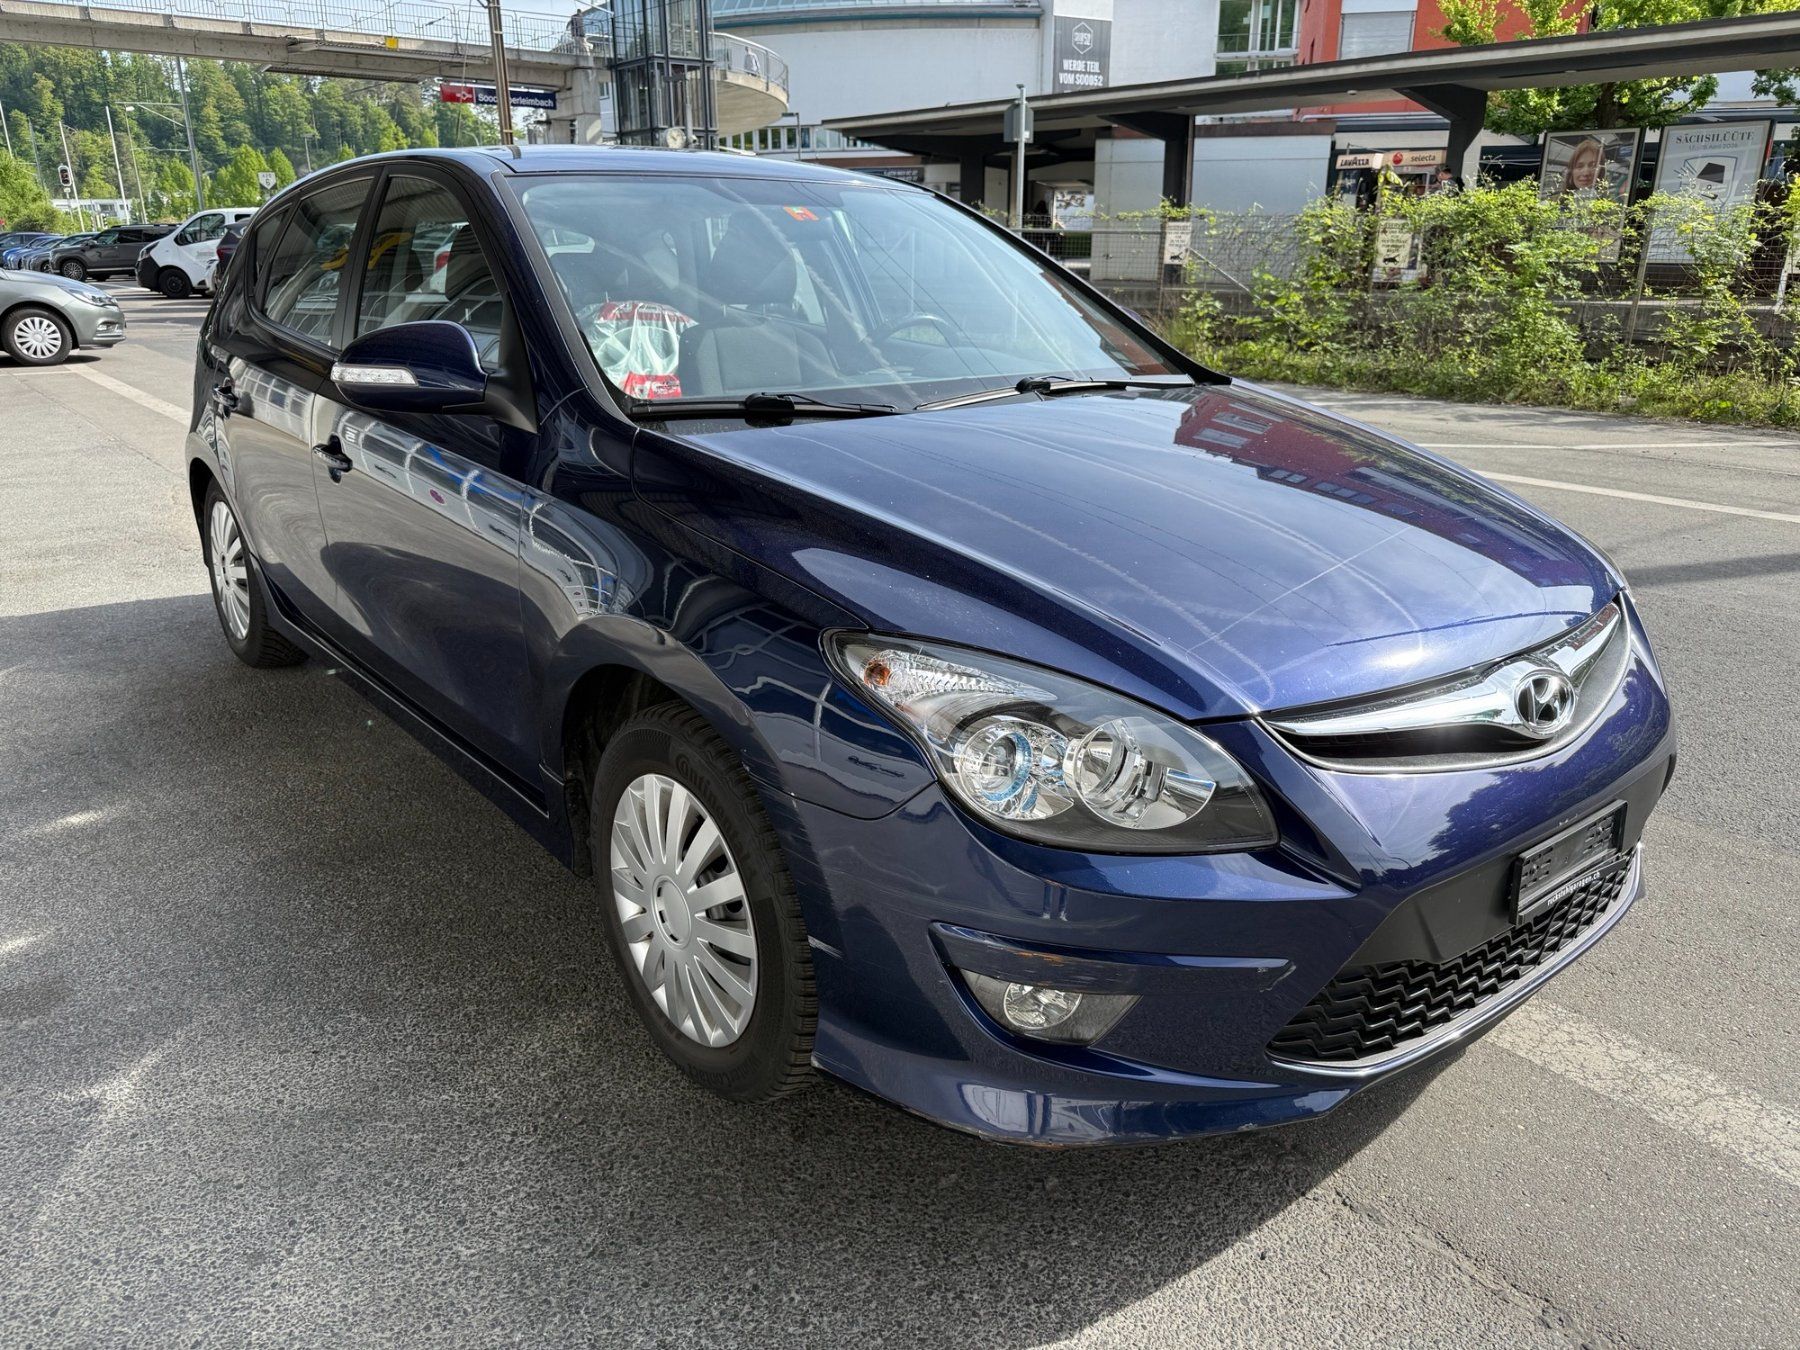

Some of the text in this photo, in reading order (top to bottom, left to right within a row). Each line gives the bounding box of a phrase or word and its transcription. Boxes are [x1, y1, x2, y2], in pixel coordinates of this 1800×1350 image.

[1063, 59, 1100, 73] WERDE TEIL
[1059, 72, 1074, 84] VOM
[1340, 157, 1370, 167] LAVAZZA
[1411, 154, 1436, 162] selecta
